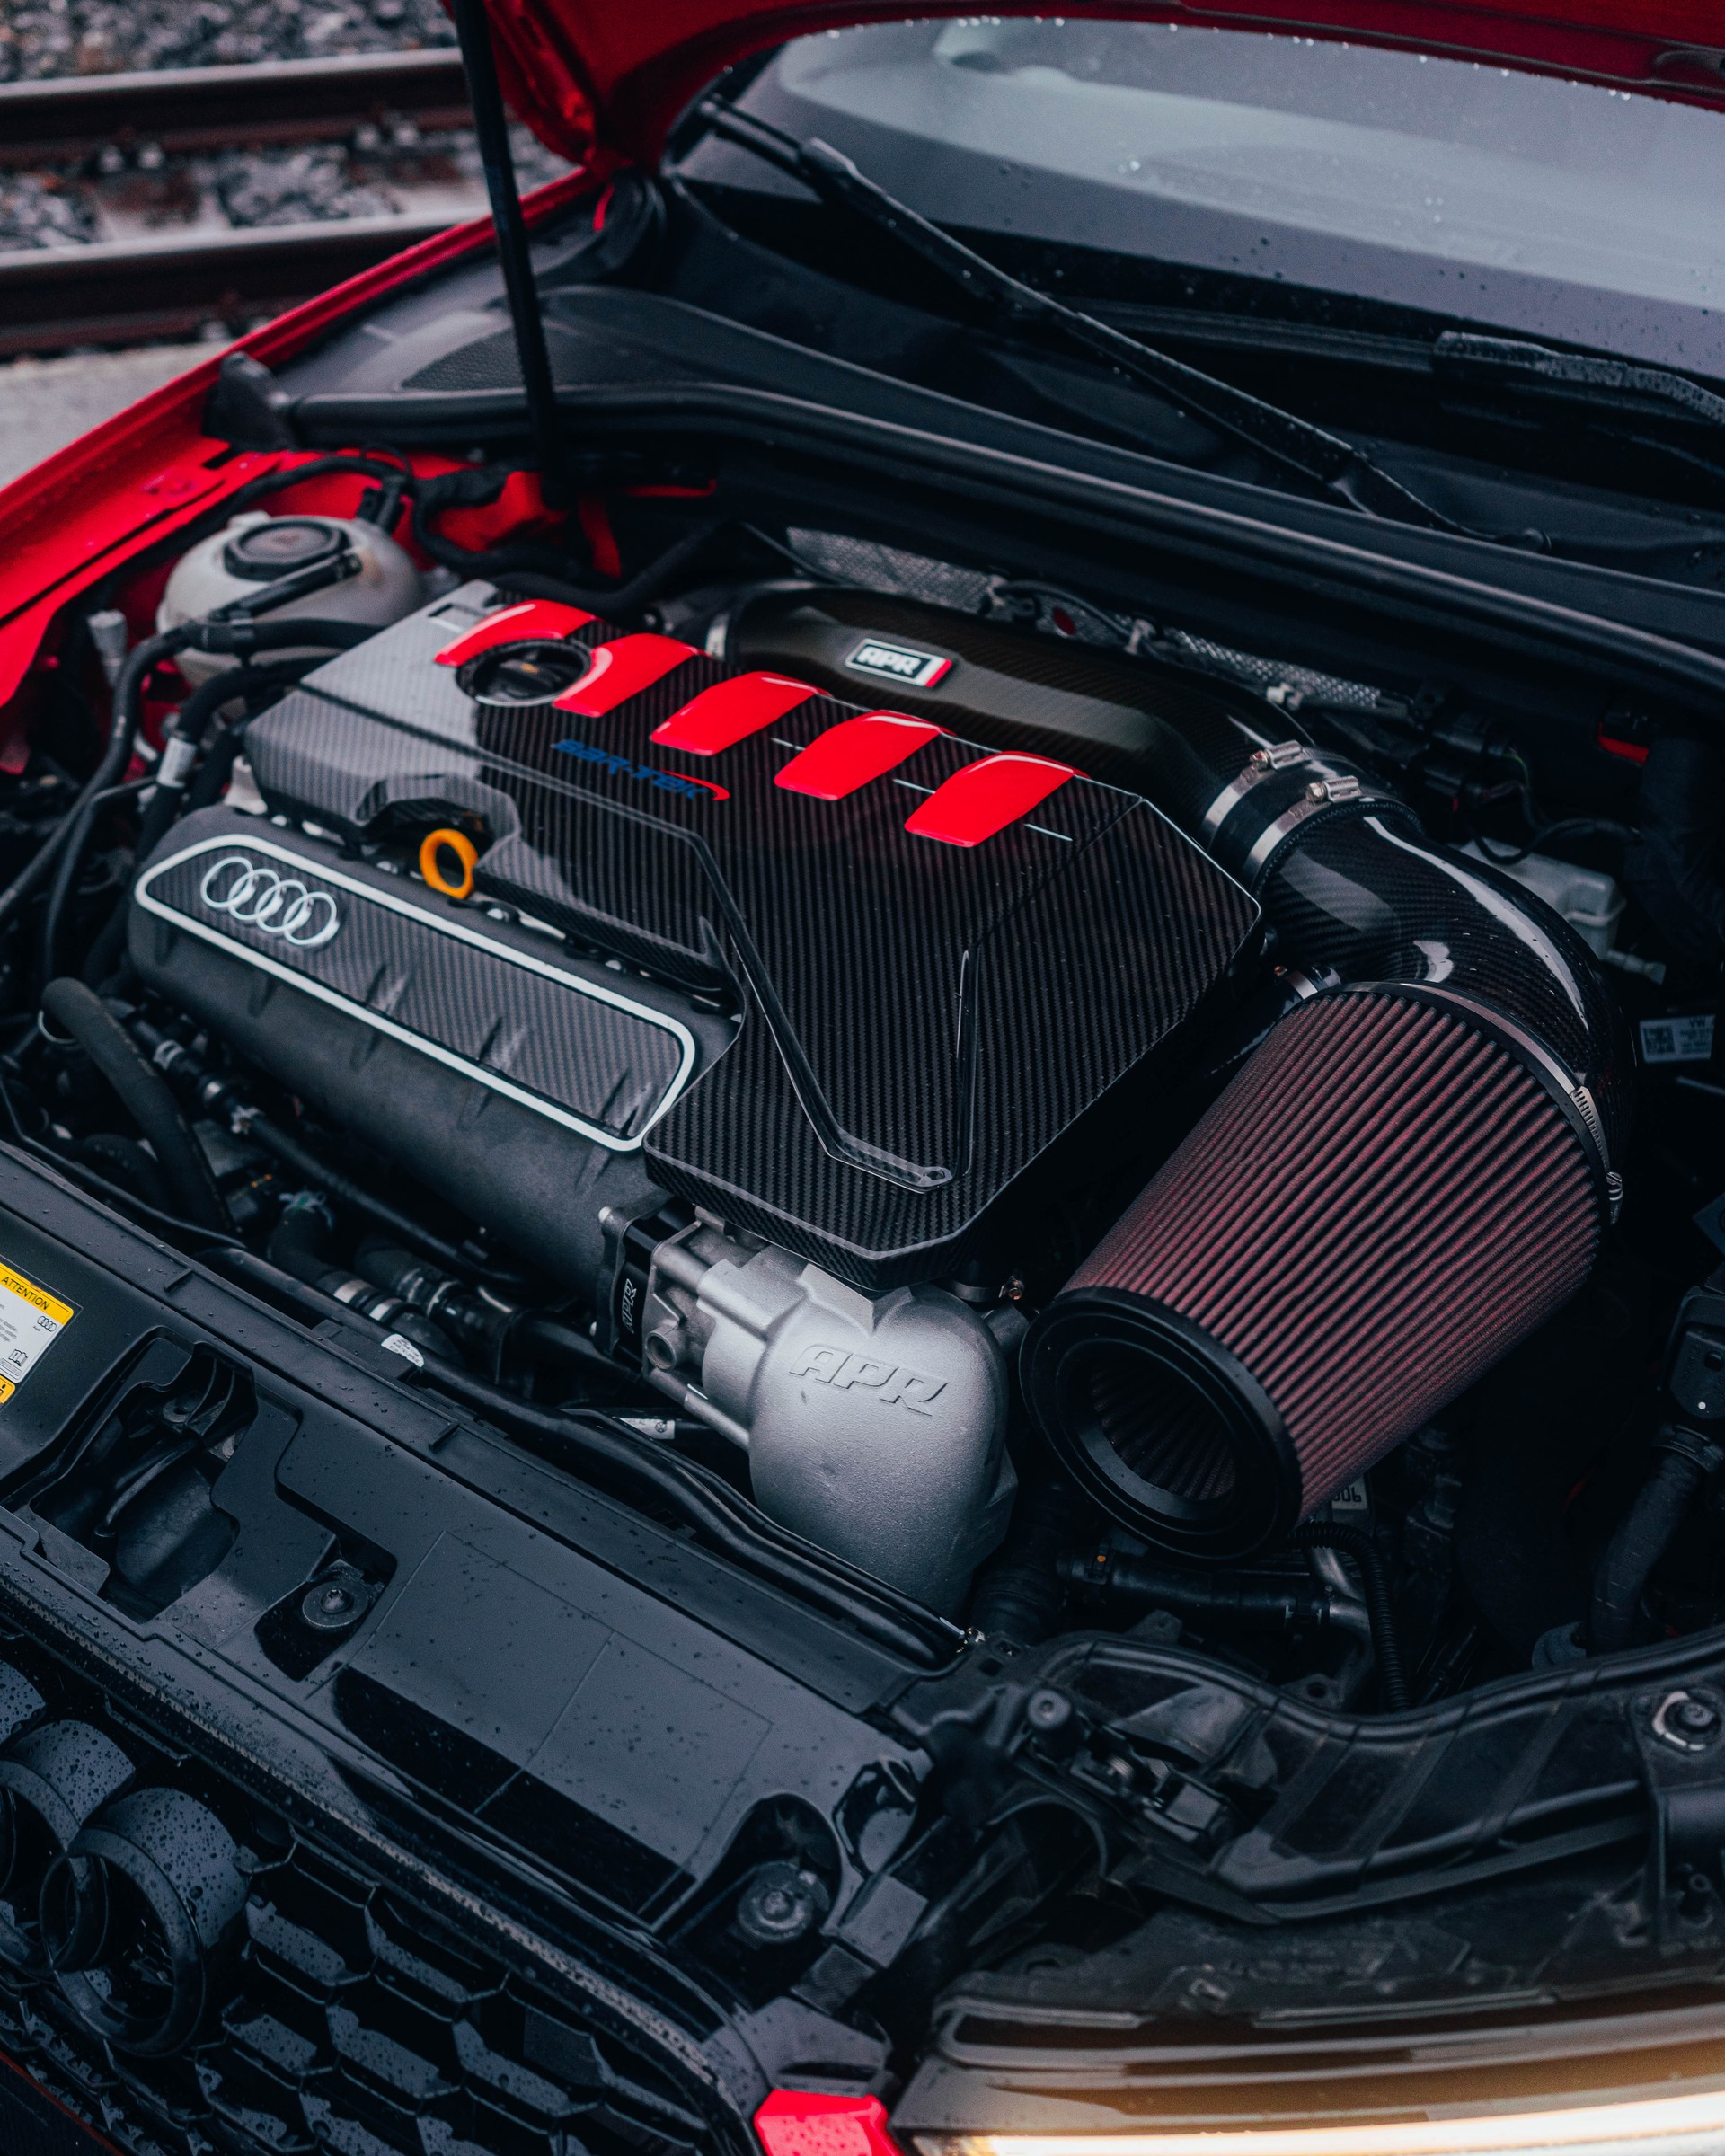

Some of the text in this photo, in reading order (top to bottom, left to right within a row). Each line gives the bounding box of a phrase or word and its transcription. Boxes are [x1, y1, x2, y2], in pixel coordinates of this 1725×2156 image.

[856, 646, 922, 676] APR
[2, 1276, 50, 1311] ATTENTION
[621, 1277, 637, 1335] APR
[788, 1343, 949, 1417] APR
